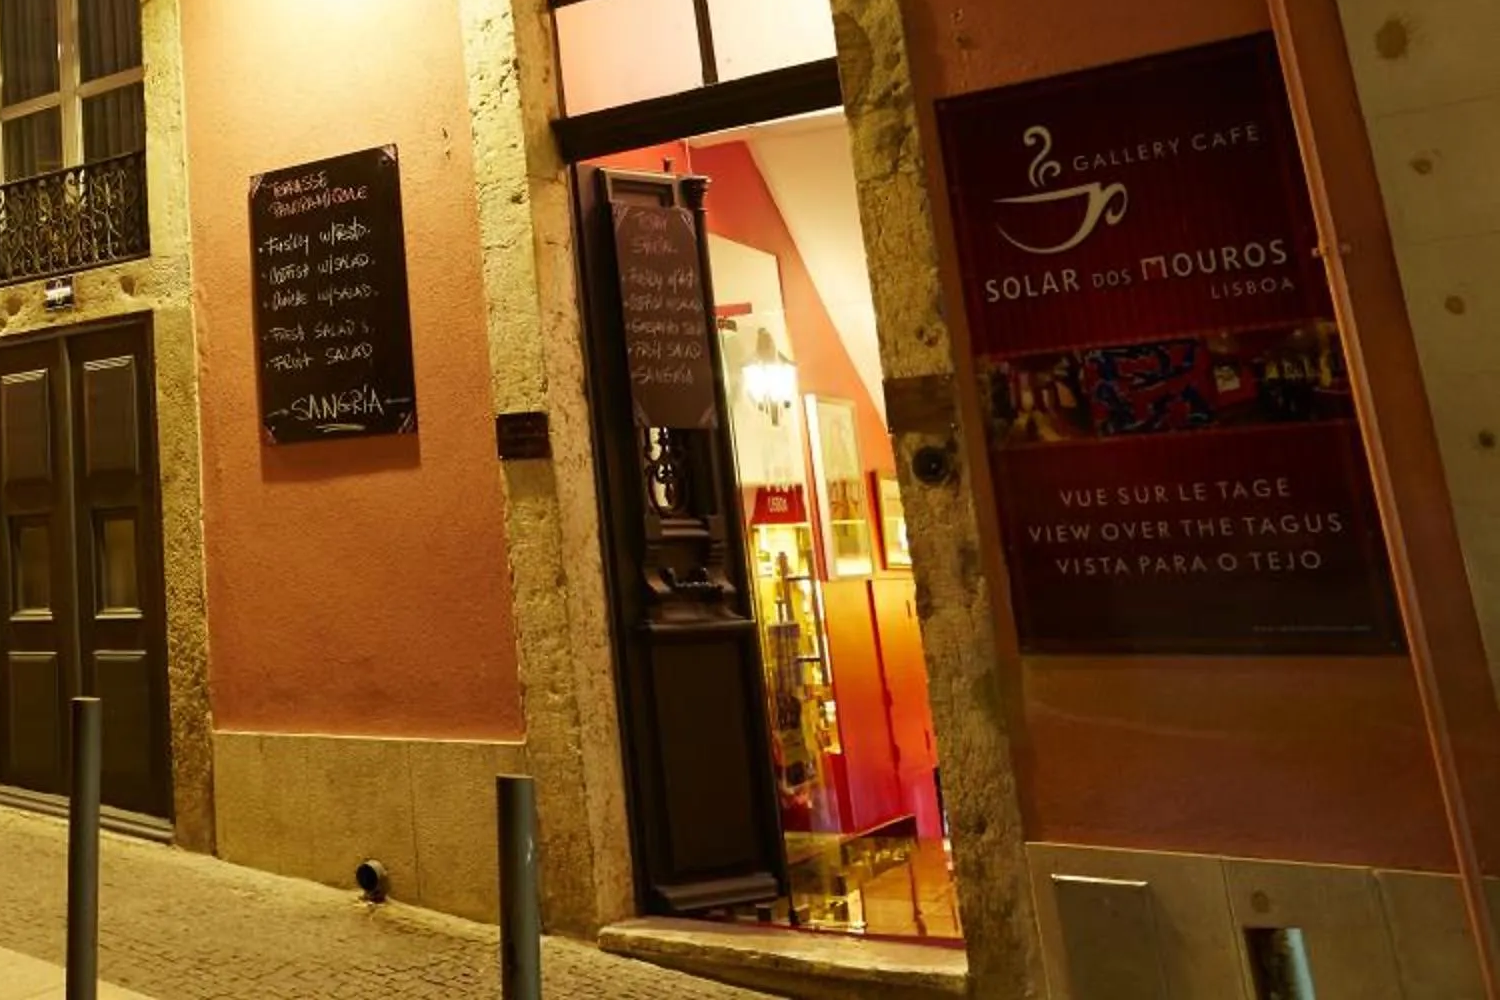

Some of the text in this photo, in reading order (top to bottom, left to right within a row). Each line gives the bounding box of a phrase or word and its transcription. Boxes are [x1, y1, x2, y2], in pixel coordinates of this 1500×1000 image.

[1072, 124, 1260, 172] GALLERY CAFE
[985, 238, 1288, 303] SOLAR DOS MOUROS
[1210, 276, 1295, 300] LISBOA
[1059, 477, 1291, 507] VUE SUR LE TAGE
[1028, 512, 1343, 543] VIEW OVER THE TAGUS
[1056, 550, 1322, 576] VISTA PARA O TEJO
